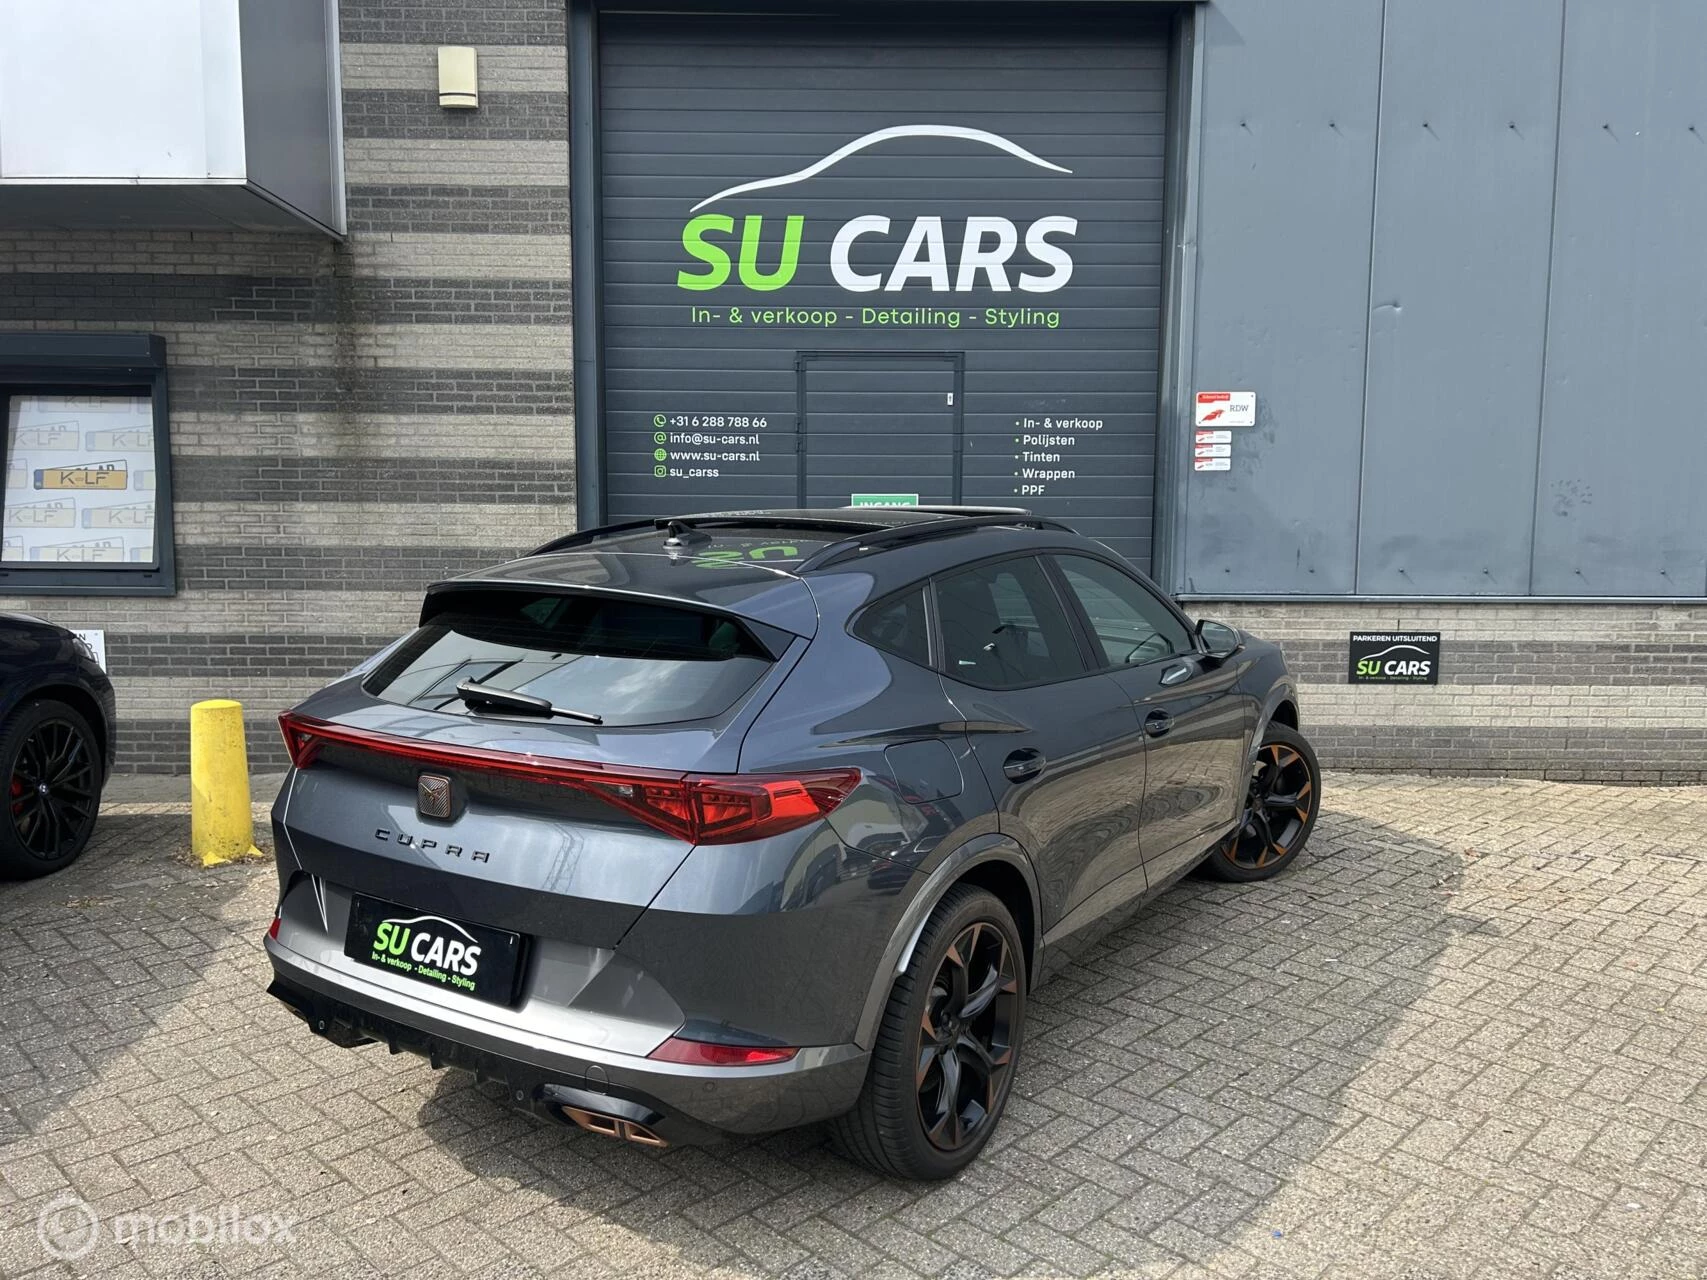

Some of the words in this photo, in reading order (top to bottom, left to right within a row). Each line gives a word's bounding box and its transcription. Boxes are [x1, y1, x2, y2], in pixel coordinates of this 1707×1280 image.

[677, 213, 805, 291] SU
[830, 215, 1078, 293] CARS
[691, 306, 721, 323] In-
[728, 306, 743, 323] &
[751, 307, 838, 327] verkoop
[862, 307, 960, 328] Detailing
[985, 308, 1060, 328] Styling
[1229, 404, 1249, 412] RDW
[669, 415, 689, 427] +31
[691, 416, 700, 427] 6
[702, 416, 725, 427] 288
[727, 416, 750, 428] 788
[752, 417, 768, 428] 66
[1023, 417, 1040, 428] In-
[1043, 417, 1053, 429] &
[1055, 417, 1103, 430] verkoop
[669, 432, 760, 445] info@su-cars.nl
[1023, 434, 1075, 448] Polijsten
[669, 451, 760, 462] www.su-cars.nl
[1022, 451, 1060, 462] Tinten
[669, 468, 719, 479] su_carss
[1022, 468, 1076, 481] Wrappen
[1021, 484, 1045, 496] PPF
[1356, 660, 1381, 675] SU
[1384, 660, 1431, 676] CARS
[375, 828, 490, 863] CUPRA
[373, 922, 411, 956] SU
[411, 932, 482, 976] CARS
[386, 957, 412, 972] verkoop
[418, 965, 447, 983] Detailing
[451, 974, 476, 991] Styling
